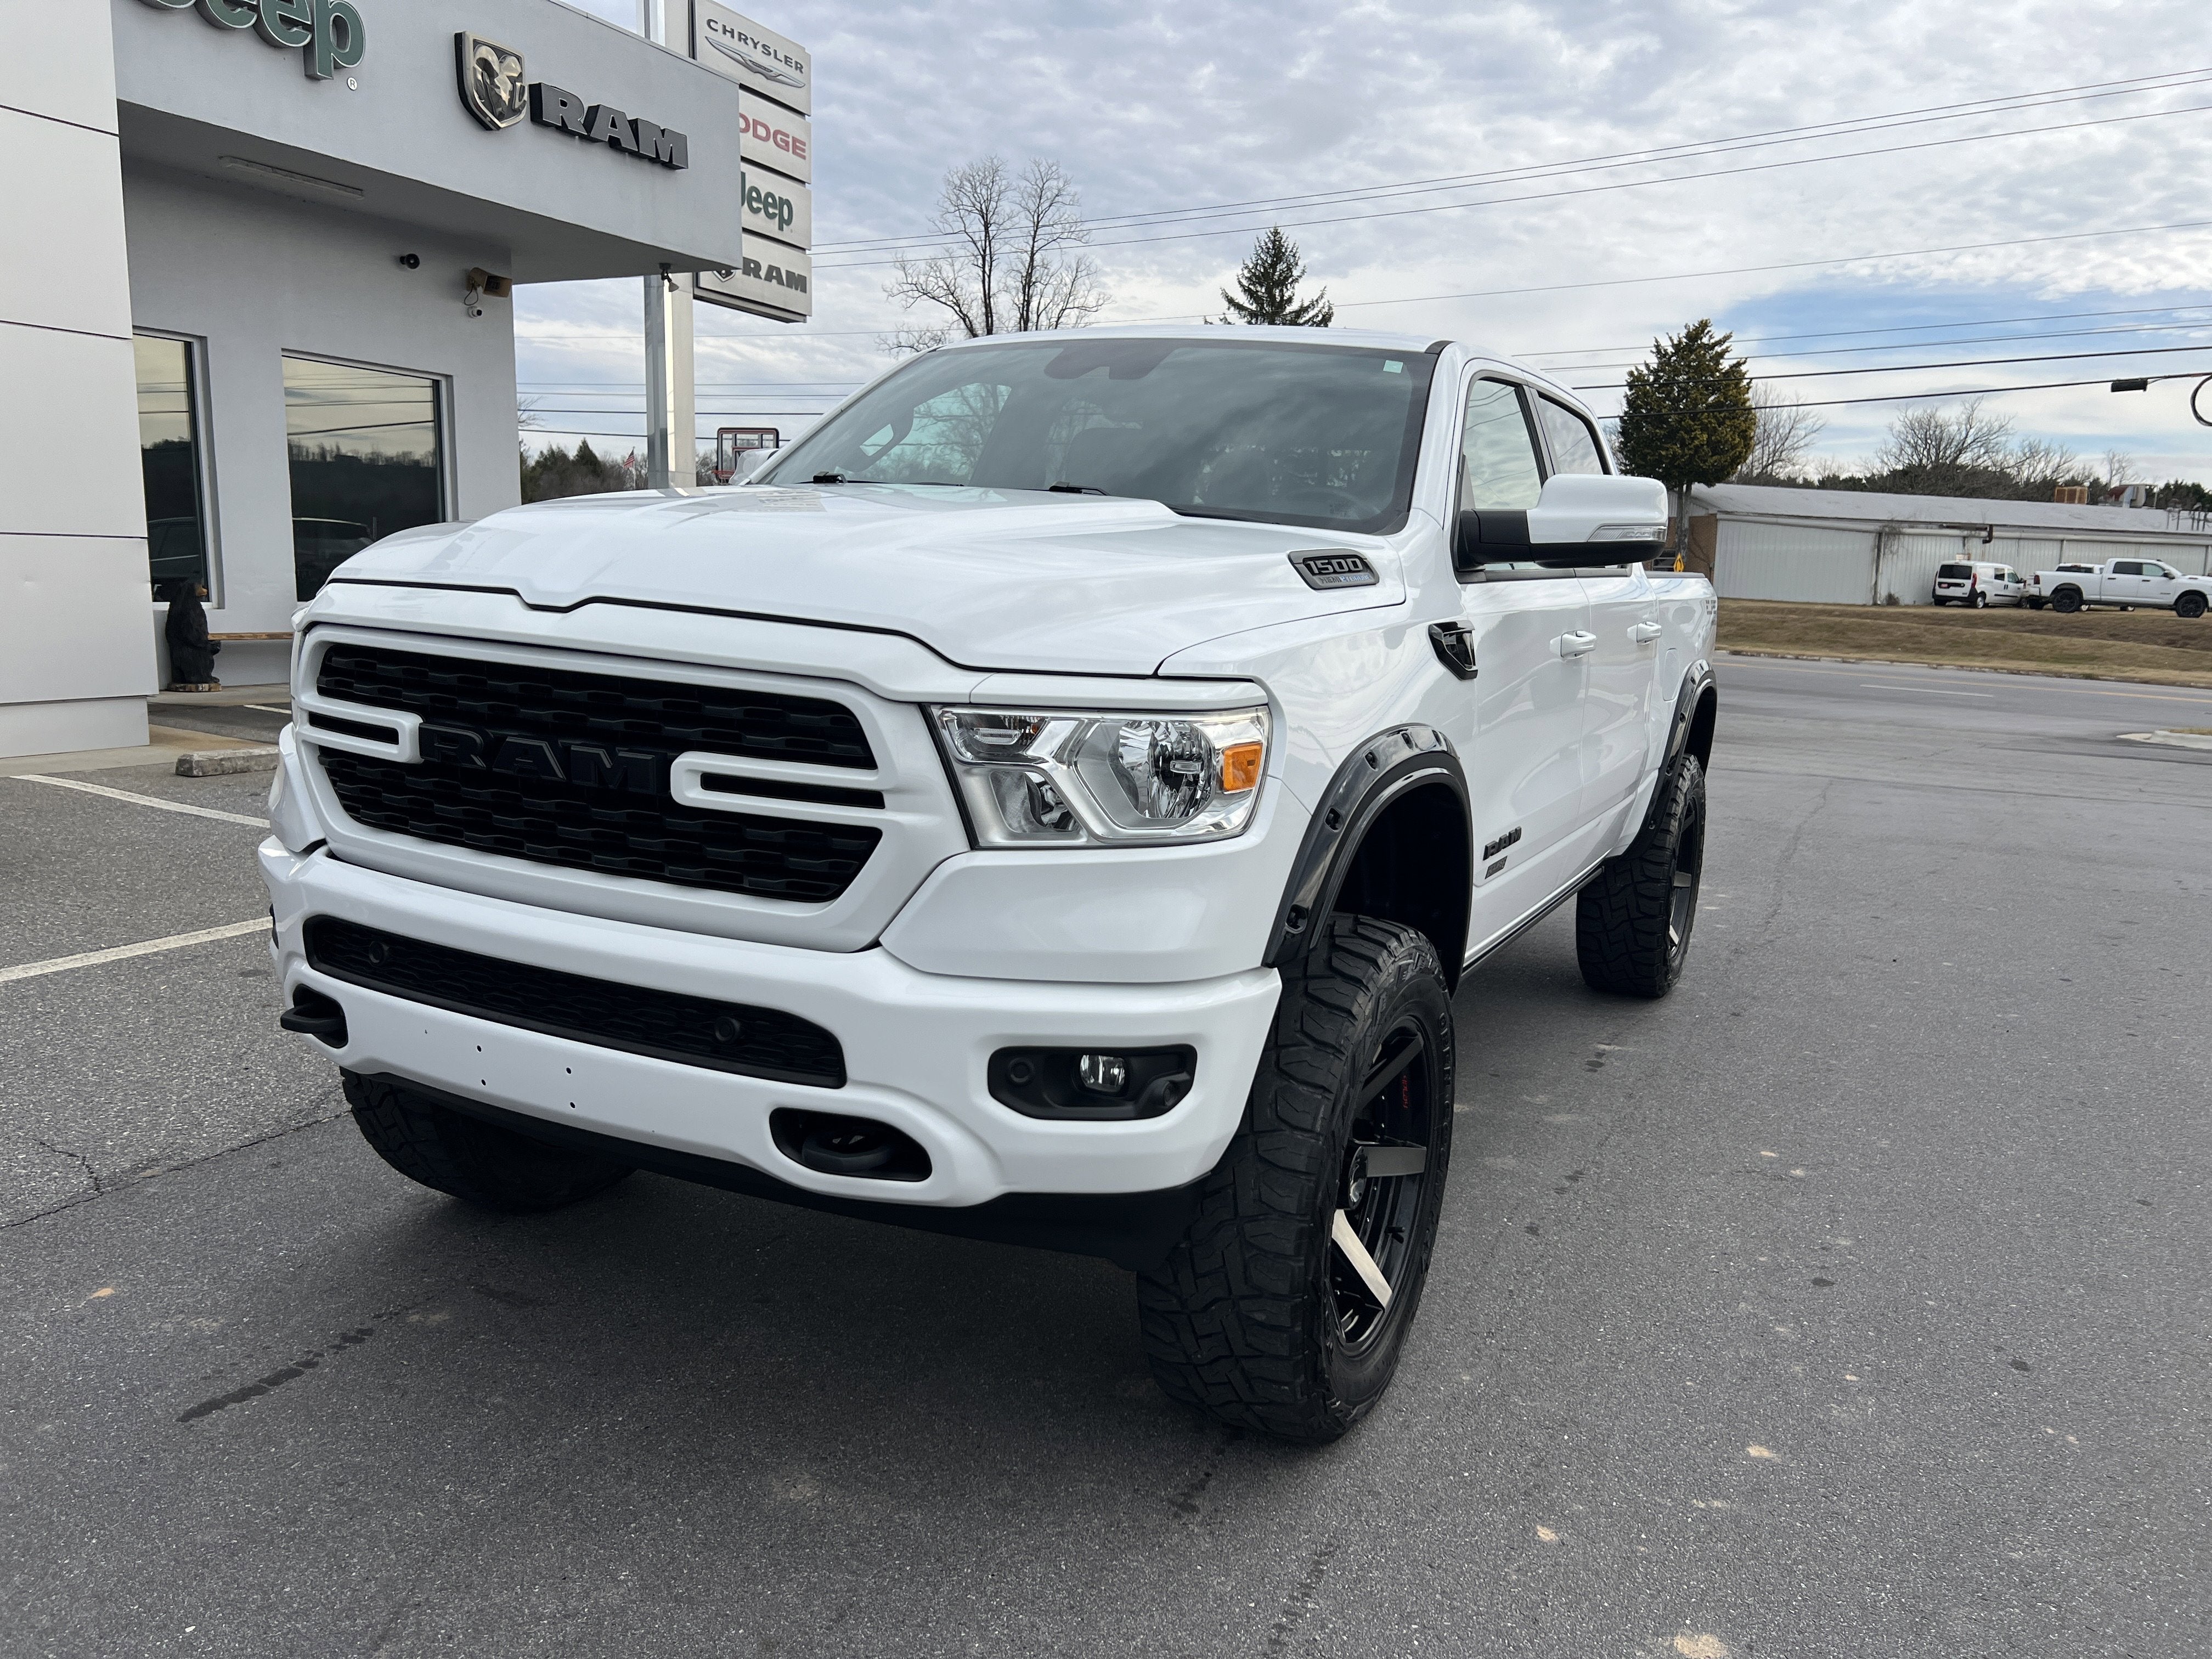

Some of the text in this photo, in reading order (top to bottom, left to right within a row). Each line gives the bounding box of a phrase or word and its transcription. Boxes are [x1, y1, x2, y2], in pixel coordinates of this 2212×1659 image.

[706, 18, 804, 74] CHRYSLER
[529, 82, 689, 170] RAM
[739, 112, 806, 160] ODGE
[742, 256, 807, 294] RAM
[1307, 558, 1363, 573] 1500
[419, 722, 657, 794] RAM
[1483, 826, 1522, 861] RAM
